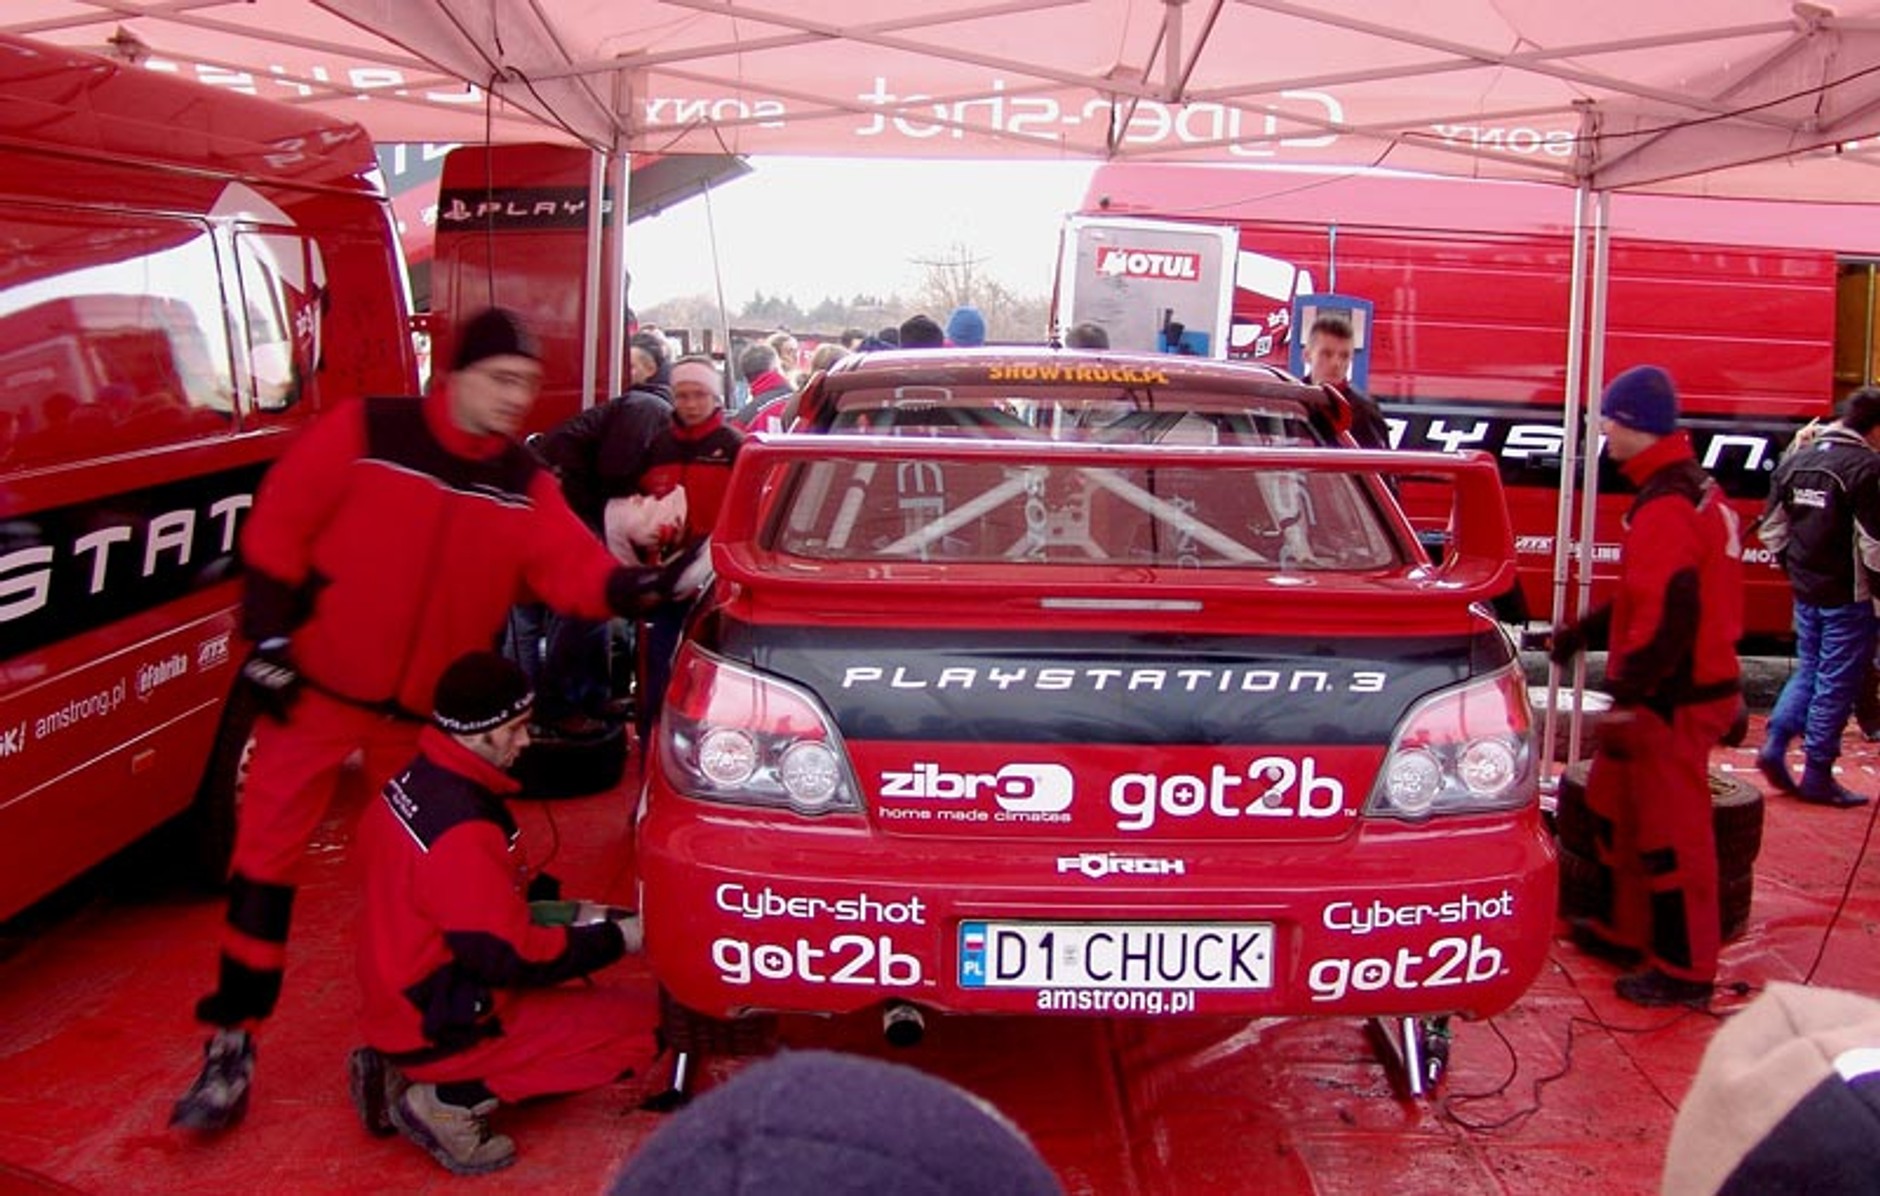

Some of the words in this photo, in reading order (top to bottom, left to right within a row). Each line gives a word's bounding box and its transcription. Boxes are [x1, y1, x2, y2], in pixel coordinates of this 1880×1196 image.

[1102, 251, 1196, 278] MOTUL
[1349, 672, 1387, 692] 3
[35, 677, 126, 740] amstrong.pl
[880, 762, 1074, 812] zibro
[1110, 757, 1344, 831] got2b
[937, 808, 989, 822] made
[716, 883, 926, 925] Cyber-shot
[1322, 889, 1514, 934] Cyber-shot
[712, 934, 922, 984] got2b
[963, 960, 984, 975] PL
[996, 931, 1054, 981] D1
[1085, 932, 1261, 982] CHUCK
[1308, 934, 1502, 1001] got2b
[1037, 989, 1195, 1014] amstrong.pl
